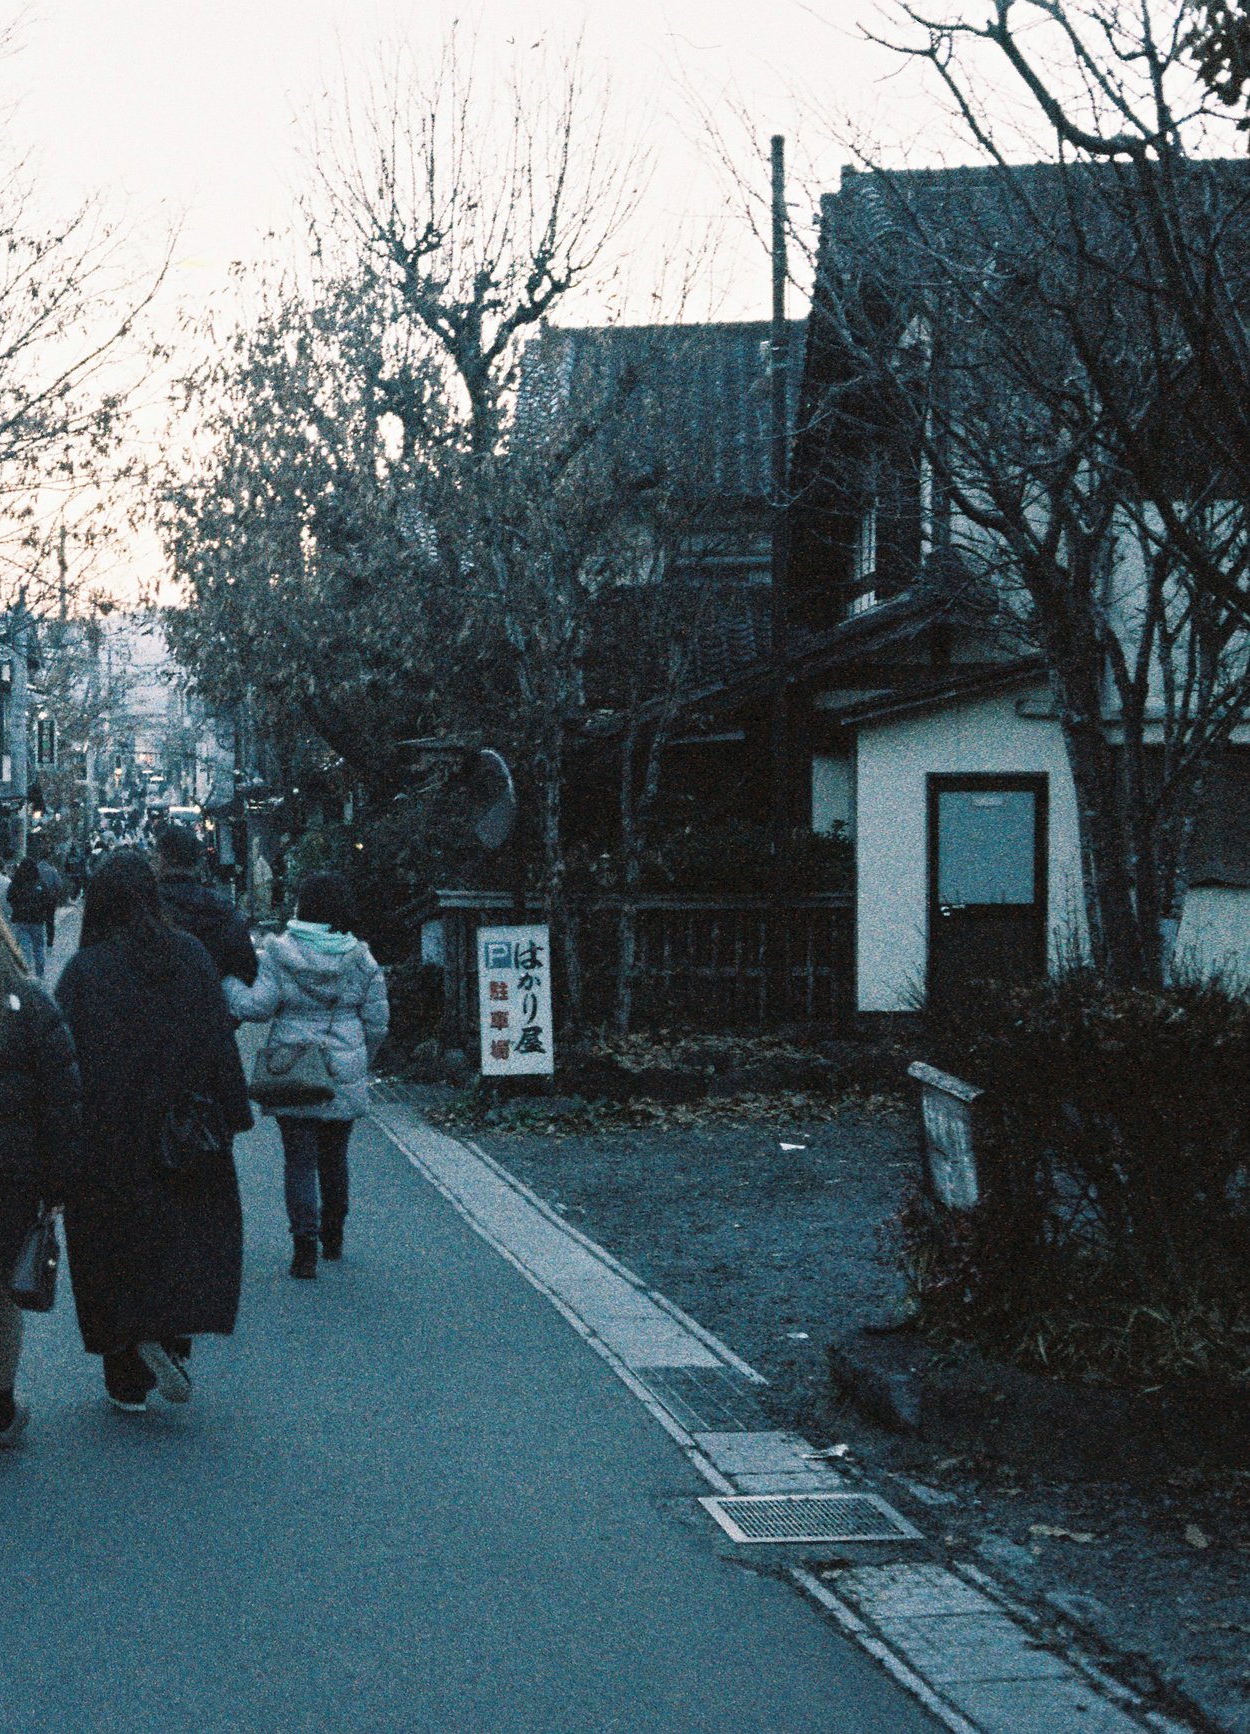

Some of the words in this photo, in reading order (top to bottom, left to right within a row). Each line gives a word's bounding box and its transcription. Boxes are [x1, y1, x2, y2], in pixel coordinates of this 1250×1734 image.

[487, 942, 510, 968] P
[489, 980, 511, 1060] 駐車場
[513, 939, 547, 1054] はかり屋
